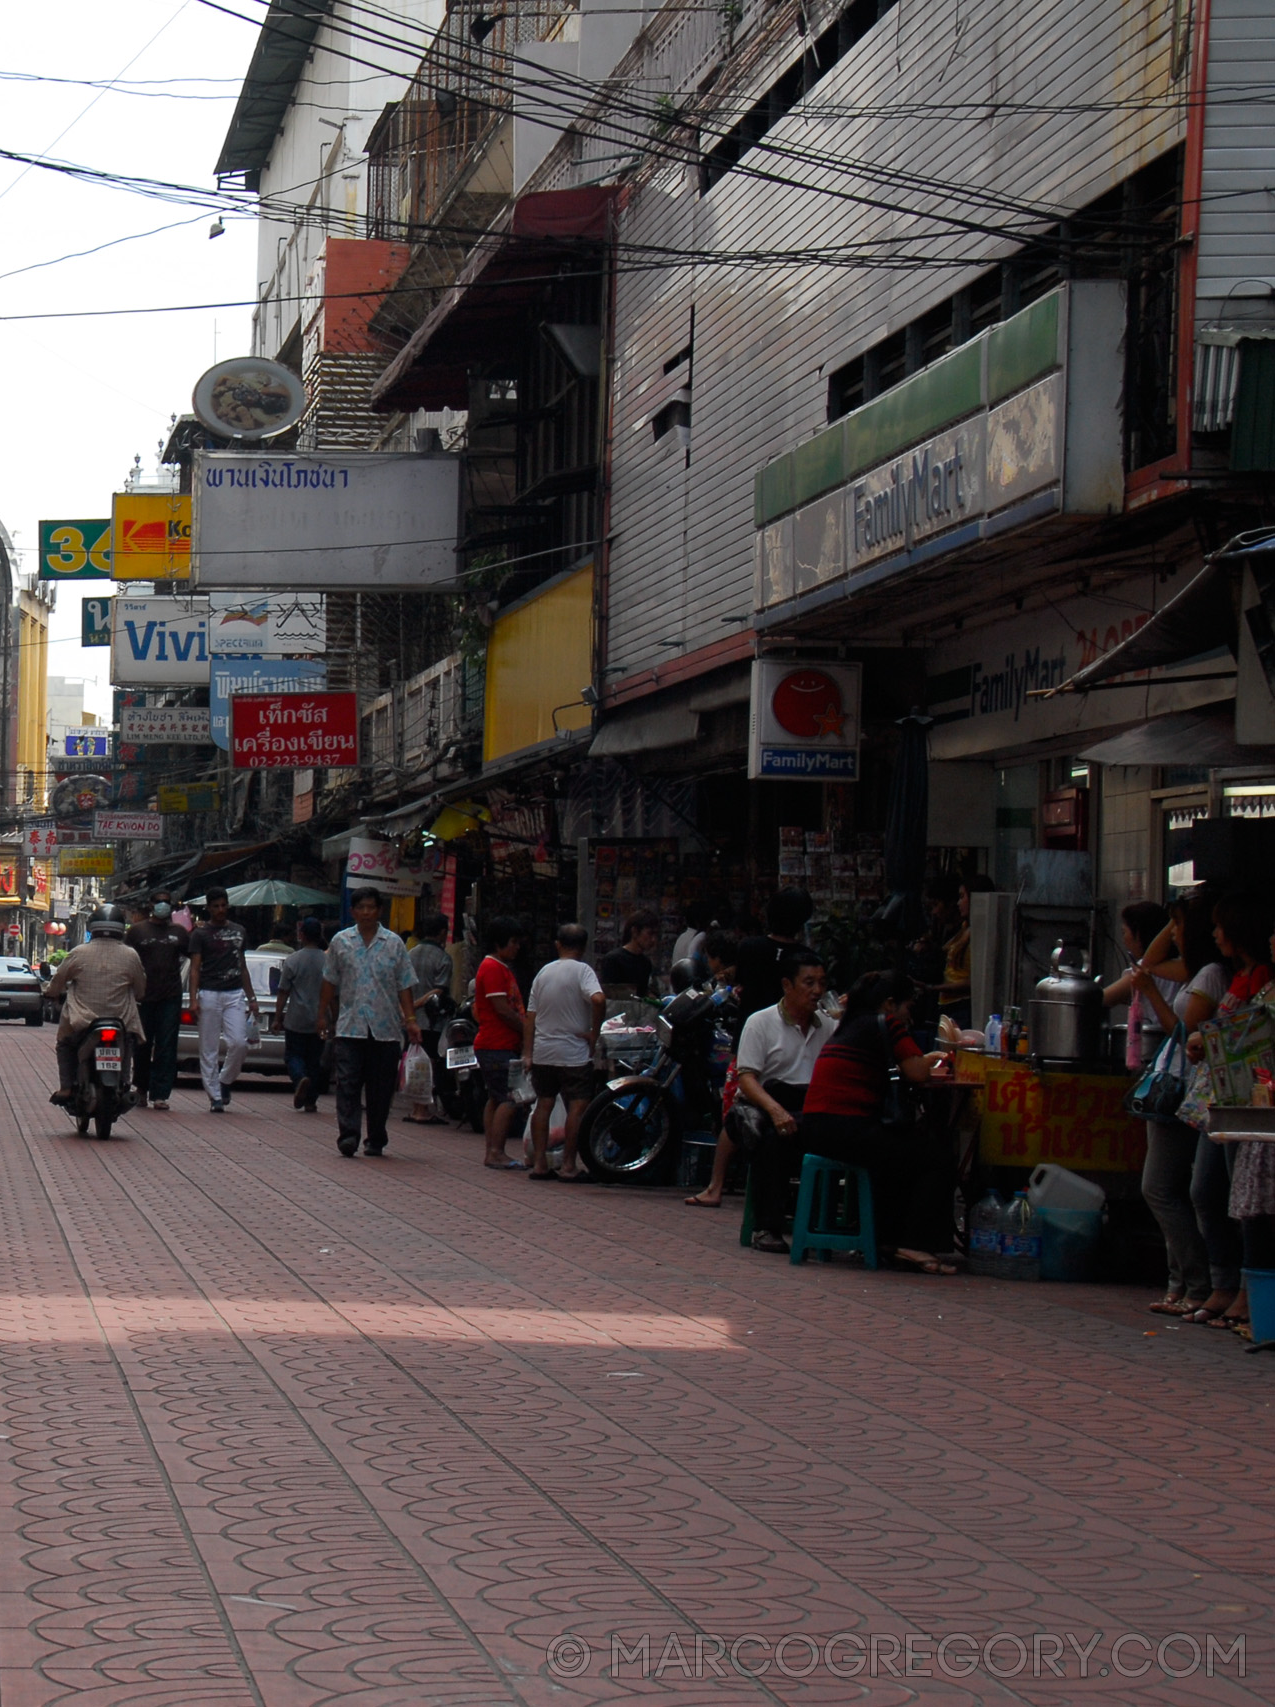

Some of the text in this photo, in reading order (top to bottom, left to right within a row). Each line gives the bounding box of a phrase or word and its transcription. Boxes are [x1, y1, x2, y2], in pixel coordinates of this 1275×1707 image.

[206, 462, 348, 489] พานเงินโภชนา
[854, 442, 965, 553] FamilyMart
[970, 644, 1067, 722] FamilyMart
[259, 702, 329, 724] เท็กซัส
[235, 727, 355, 752] เครื่องเขียน
[250, 754, 340, 768] 02-223-9437
[762, 751, 854, 772] FamilyMart
